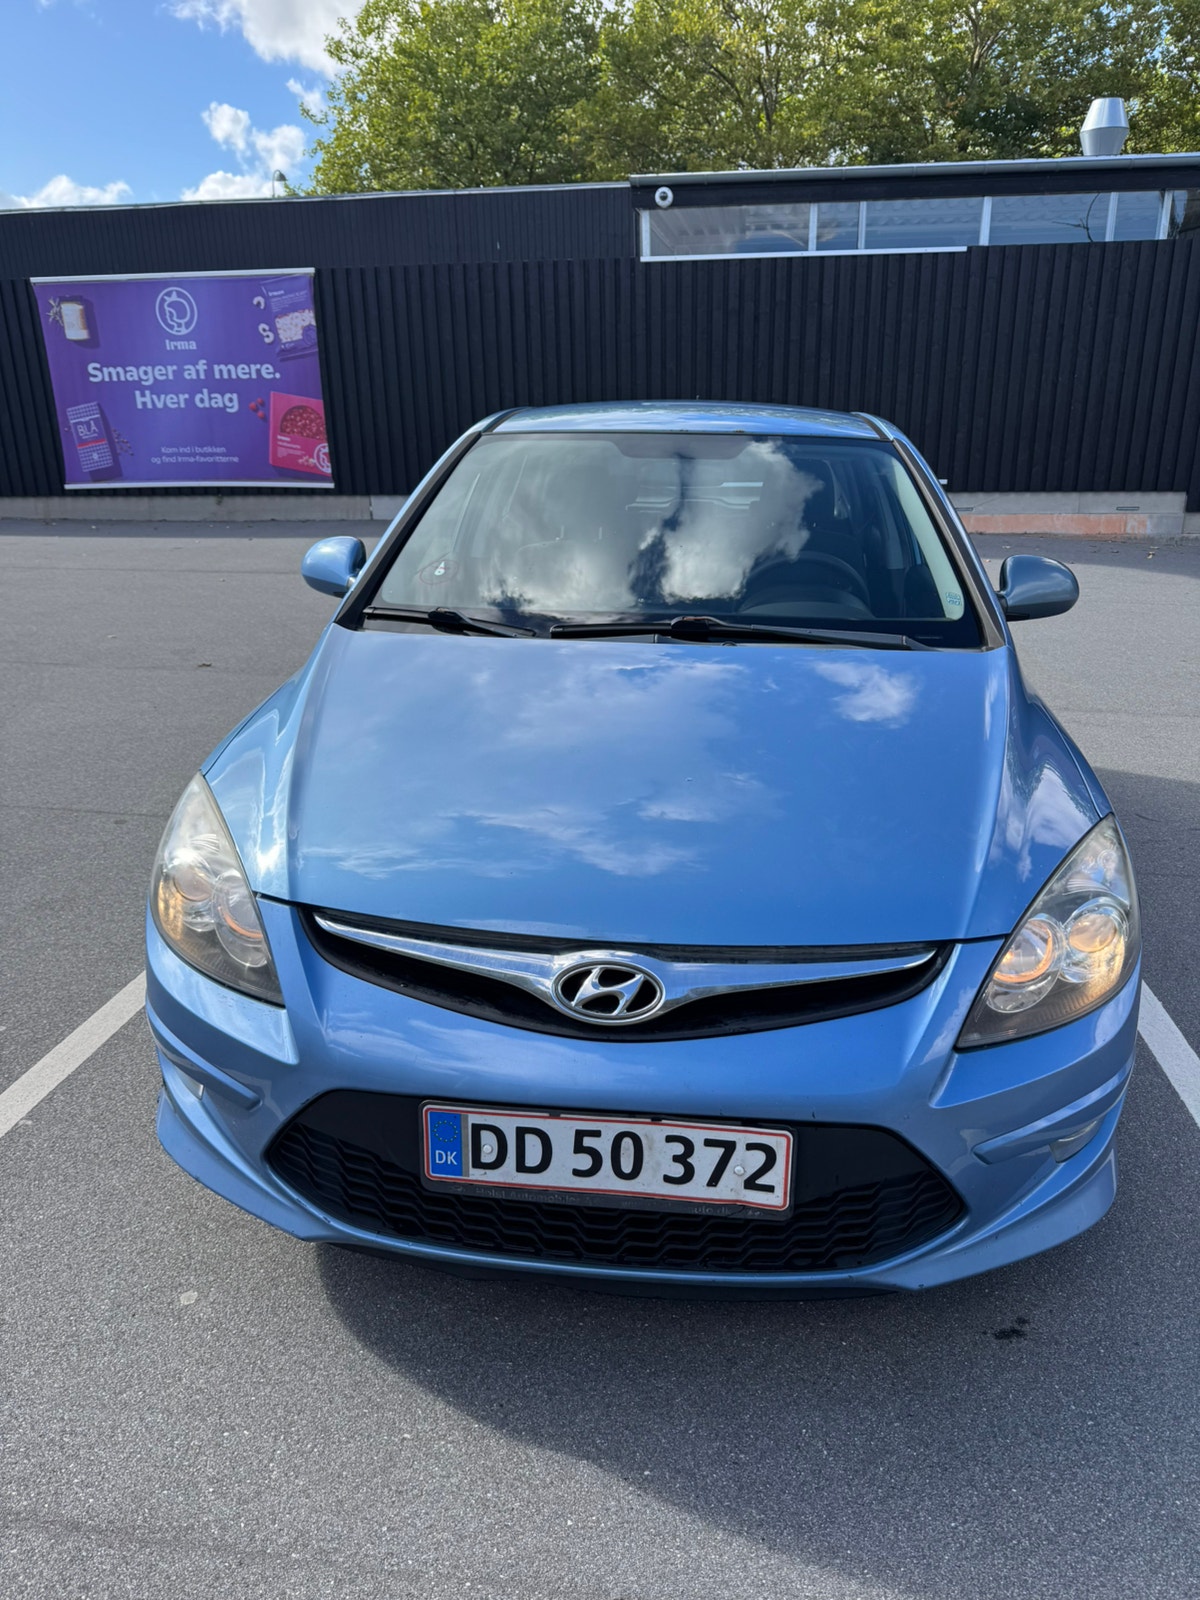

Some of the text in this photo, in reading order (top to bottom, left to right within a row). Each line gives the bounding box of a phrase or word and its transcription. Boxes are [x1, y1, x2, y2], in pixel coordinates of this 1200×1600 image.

[165, 339, 197, 351] Irma
[87, 359, 281, 386] Smager af mere.
[134, 388, 239, 413] Hver dag
[151, 456, 162, 465] og
[162, 455, 177, 463] find
[435, 1149, 458, 1166] DK
[471, 1122, 778, 1194] DD 50 372
